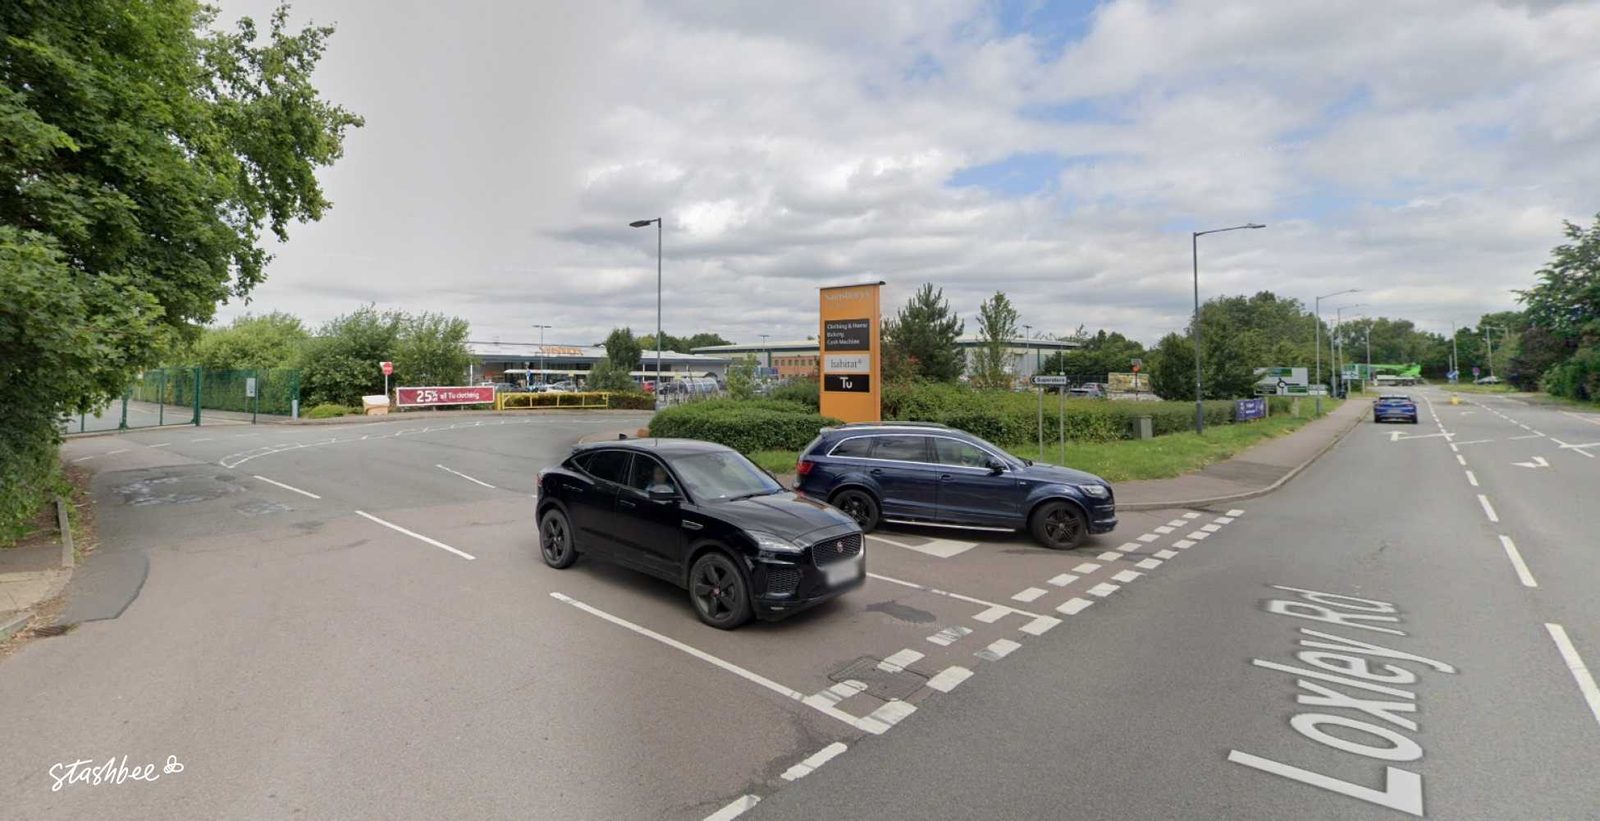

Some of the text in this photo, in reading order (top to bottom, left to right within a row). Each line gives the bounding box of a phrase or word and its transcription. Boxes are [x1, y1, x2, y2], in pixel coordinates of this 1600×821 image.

[831, 359, 857, 368] habitat
[840, 377, 852, 388] Tu
[1228, 585, 1456, 817] Loxley Rd
